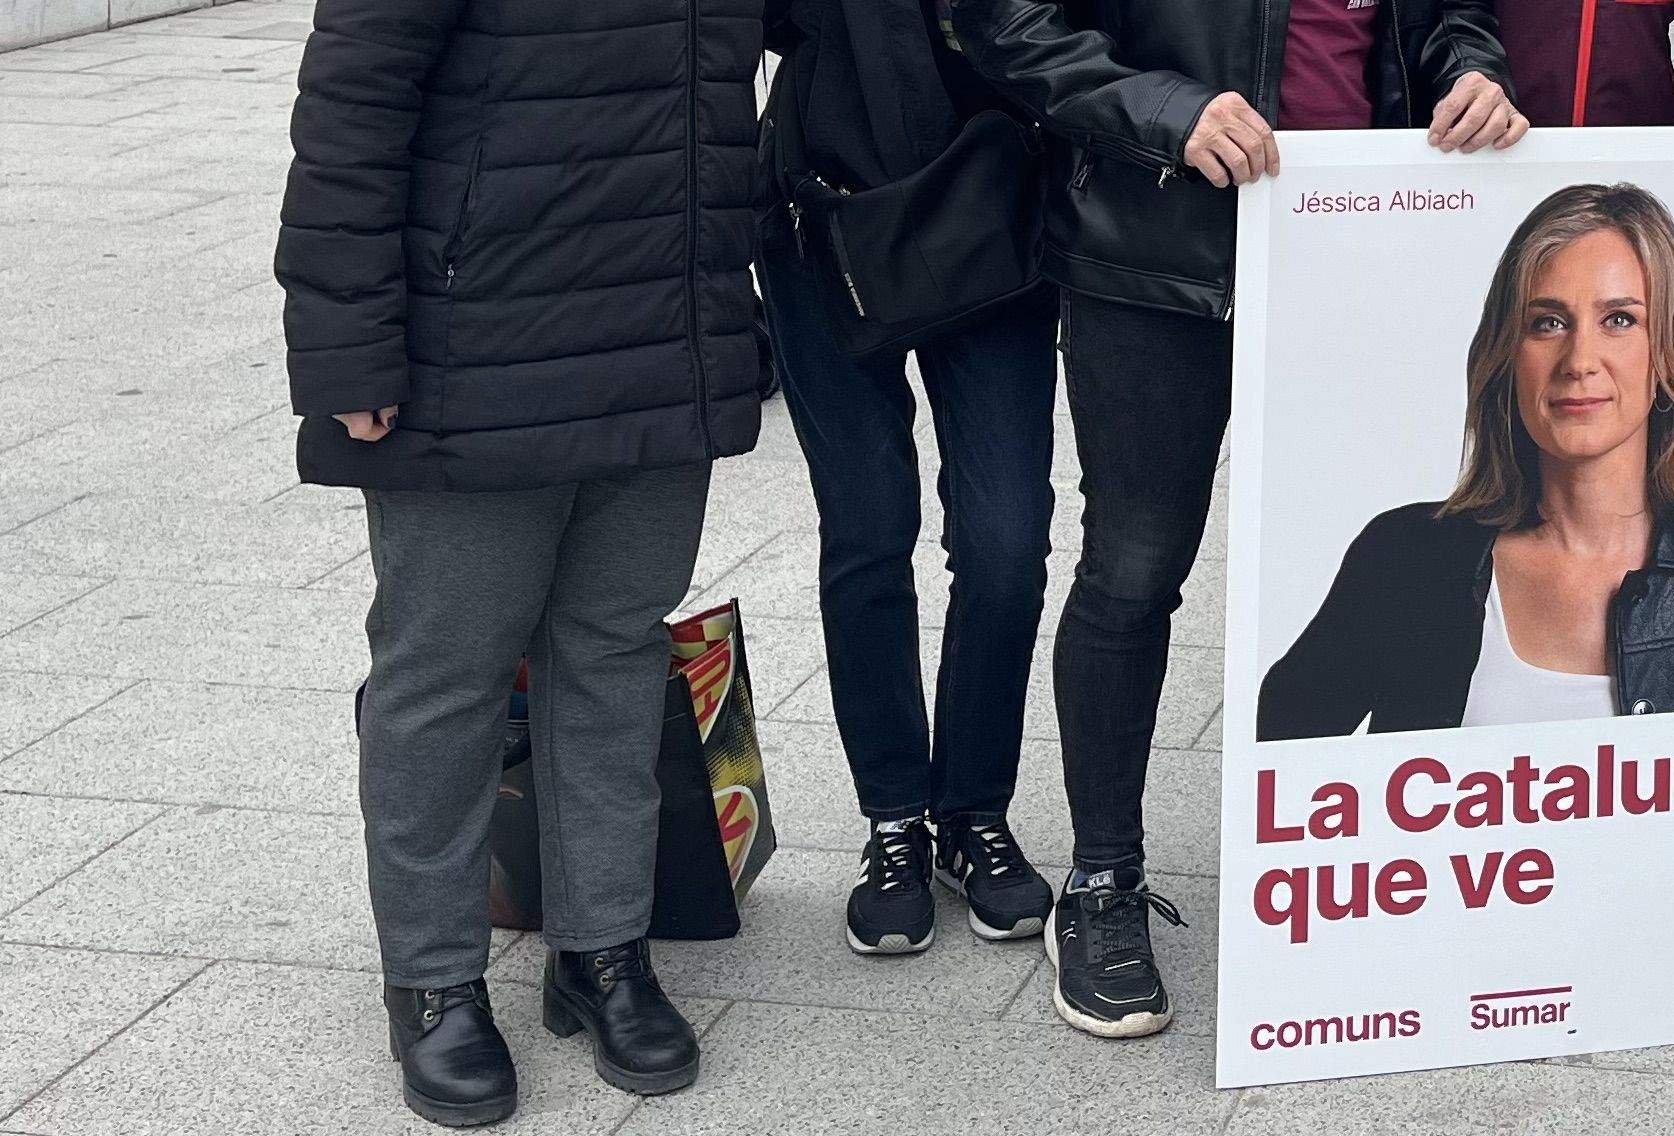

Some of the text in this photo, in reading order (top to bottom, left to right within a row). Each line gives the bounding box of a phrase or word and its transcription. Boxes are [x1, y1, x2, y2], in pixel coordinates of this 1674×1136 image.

[1292, 188, 1475, 214] Jéssica Albiach
[1257, 769, 1360, 844] La
[1252, 847, 1555, 944] que ve
[1249, 1008, 1421, 1051] comuns
[1471, 1002, 1570, 1030] Sumar
